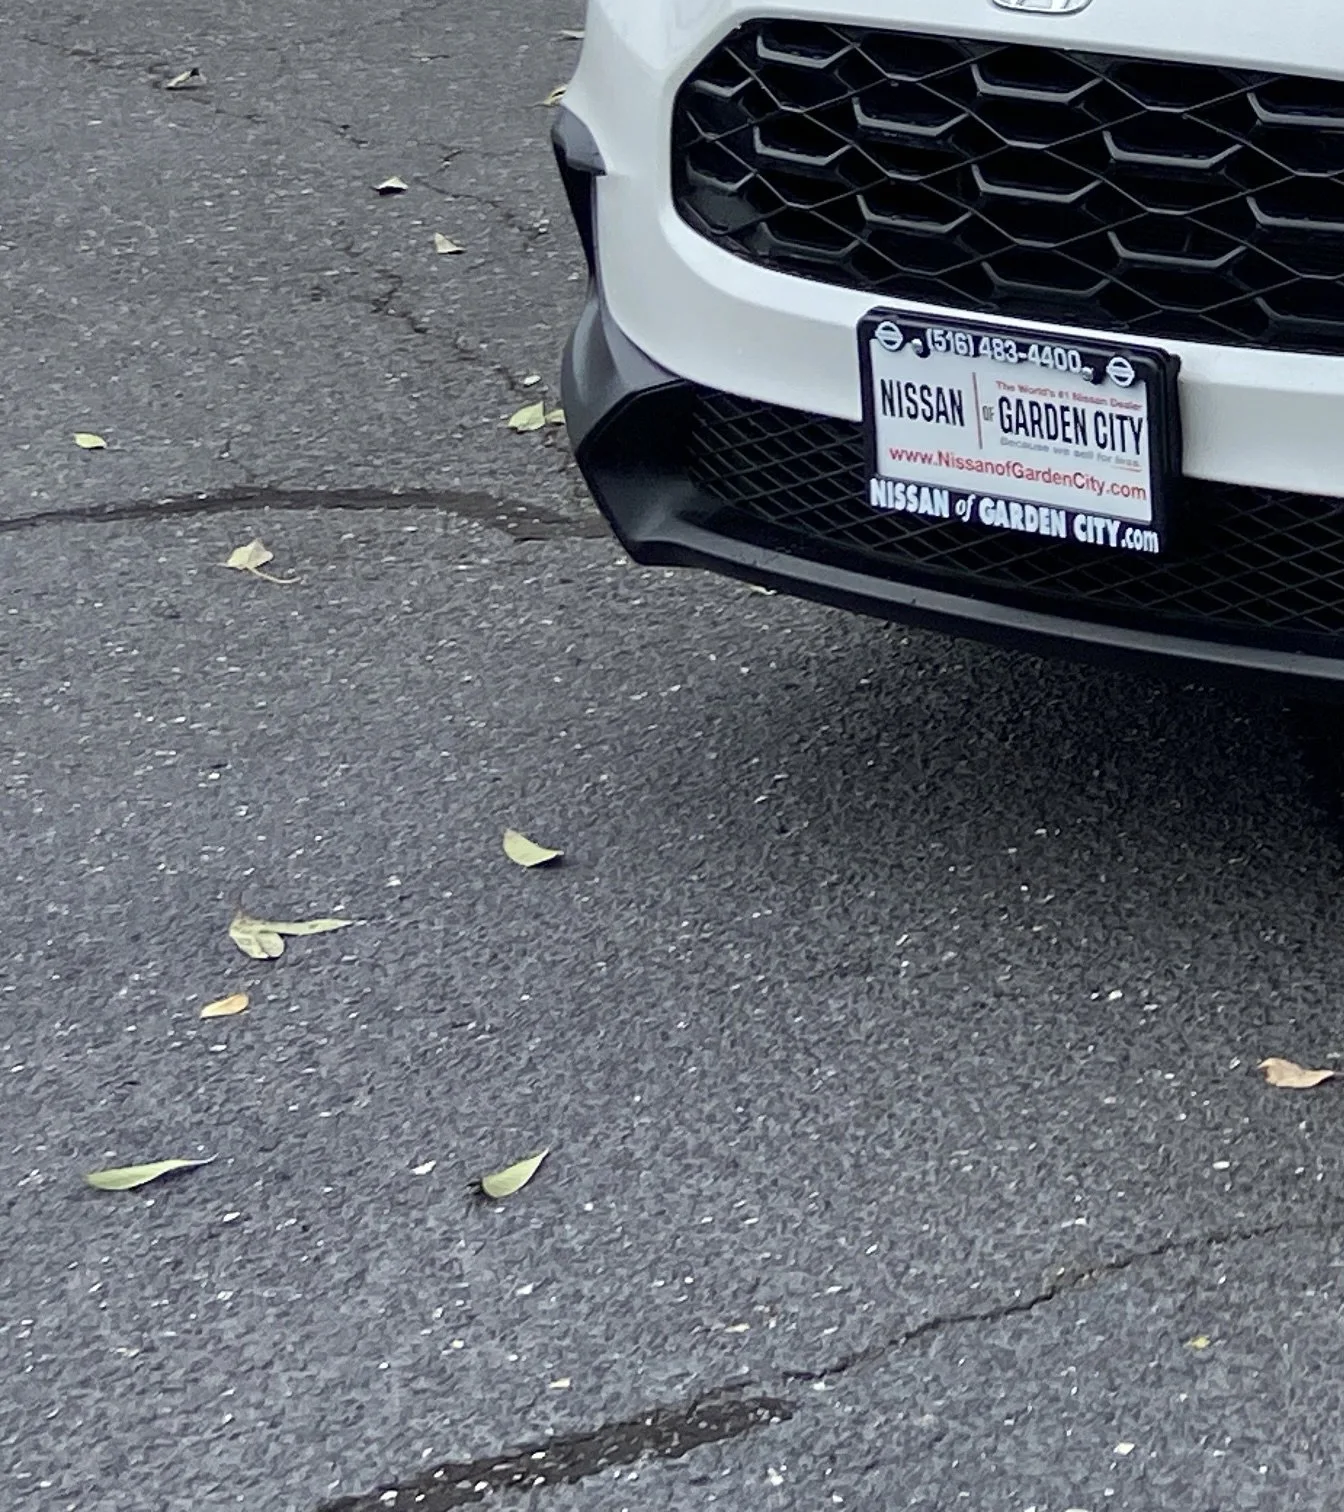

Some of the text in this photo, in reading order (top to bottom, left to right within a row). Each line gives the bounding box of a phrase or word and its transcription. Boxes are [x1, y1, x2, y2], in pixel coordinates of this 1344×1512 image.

[925, 328, 1082, 374] (516) 483-4400
[995, 380, 1016, 392] The
[880, 378, 1143, 455] NISSAN OF GARDEN CITY
[1000, 436, 1050, 452] Because
[1053, 445, 1070, 456] we
[888, 447, 1147, 501] www.NissanofGardenCity.com
[869, 477, 950, 519] NISSAN
[955, 493, 976, 523] of
[978, 496, 1068, 539] GARDEN
